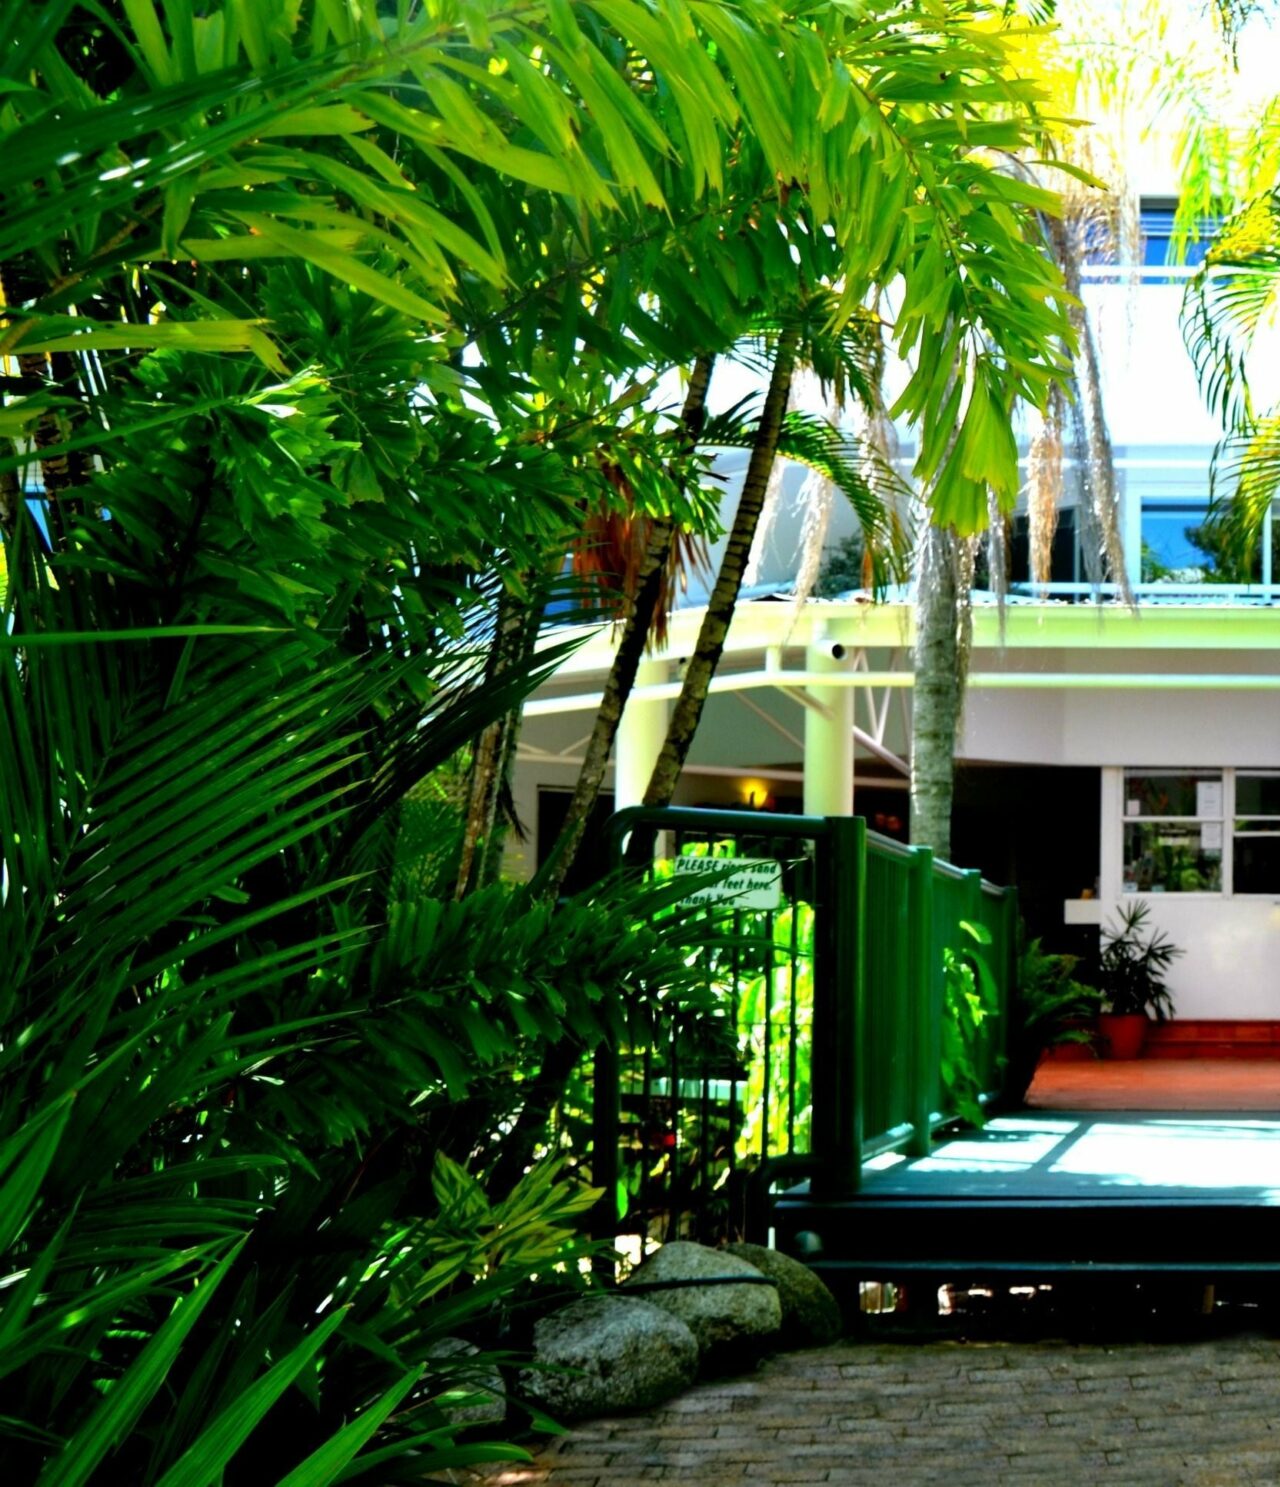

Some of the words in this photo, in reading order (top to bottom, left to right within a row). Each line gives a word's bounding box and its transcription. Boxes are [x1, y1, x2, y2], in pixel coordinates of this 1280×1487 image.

[677, 859, 719, 872] PLEASE
[722, 860, 746, 873] rin
[751, 862, 778, 874] sand
[722, 877, 744, 890] feet
